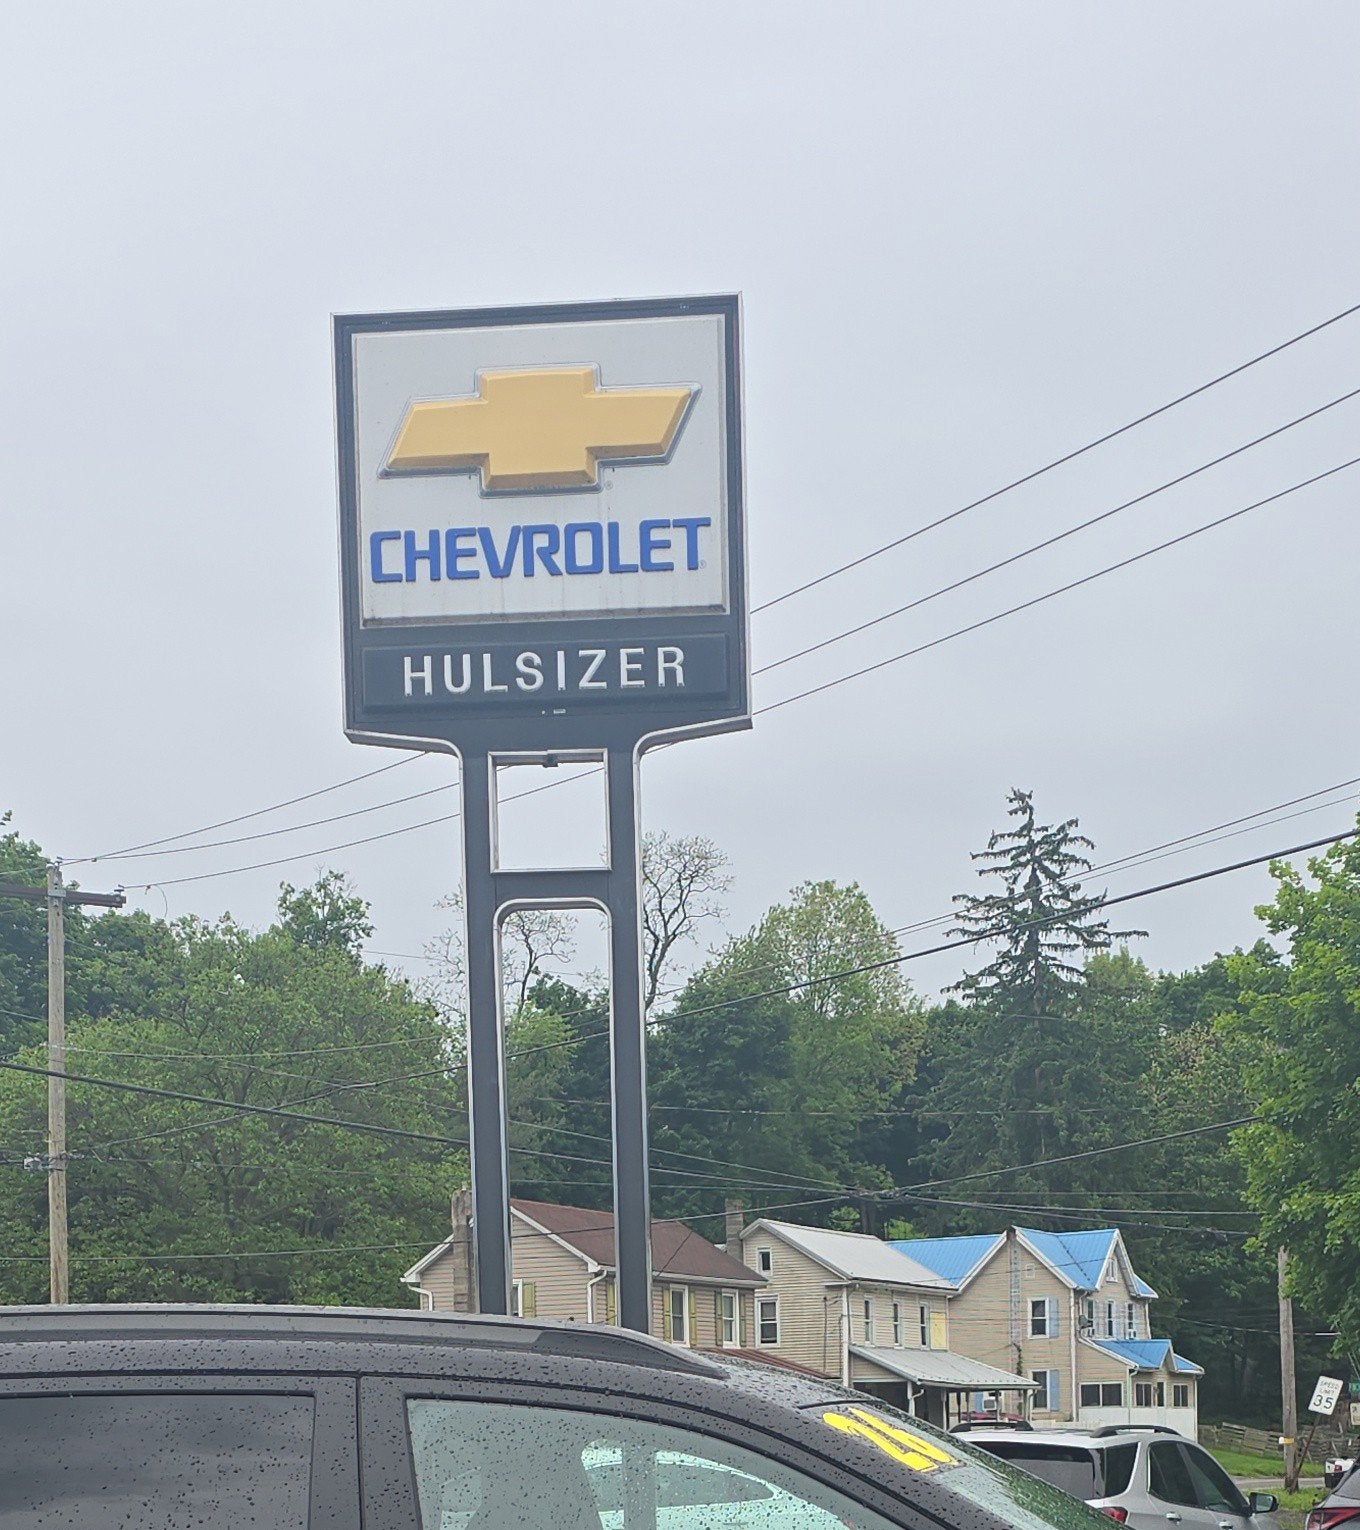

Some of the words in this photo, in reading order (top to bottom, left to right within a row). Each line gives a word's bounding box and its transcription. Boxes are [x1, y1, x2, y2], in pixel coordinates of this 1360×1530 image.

[369, 516, 711, 583] CHEVROLET
[403, 646, 685, 696] HULSIZER
[1313, 1394, 1334, 1409] 35
